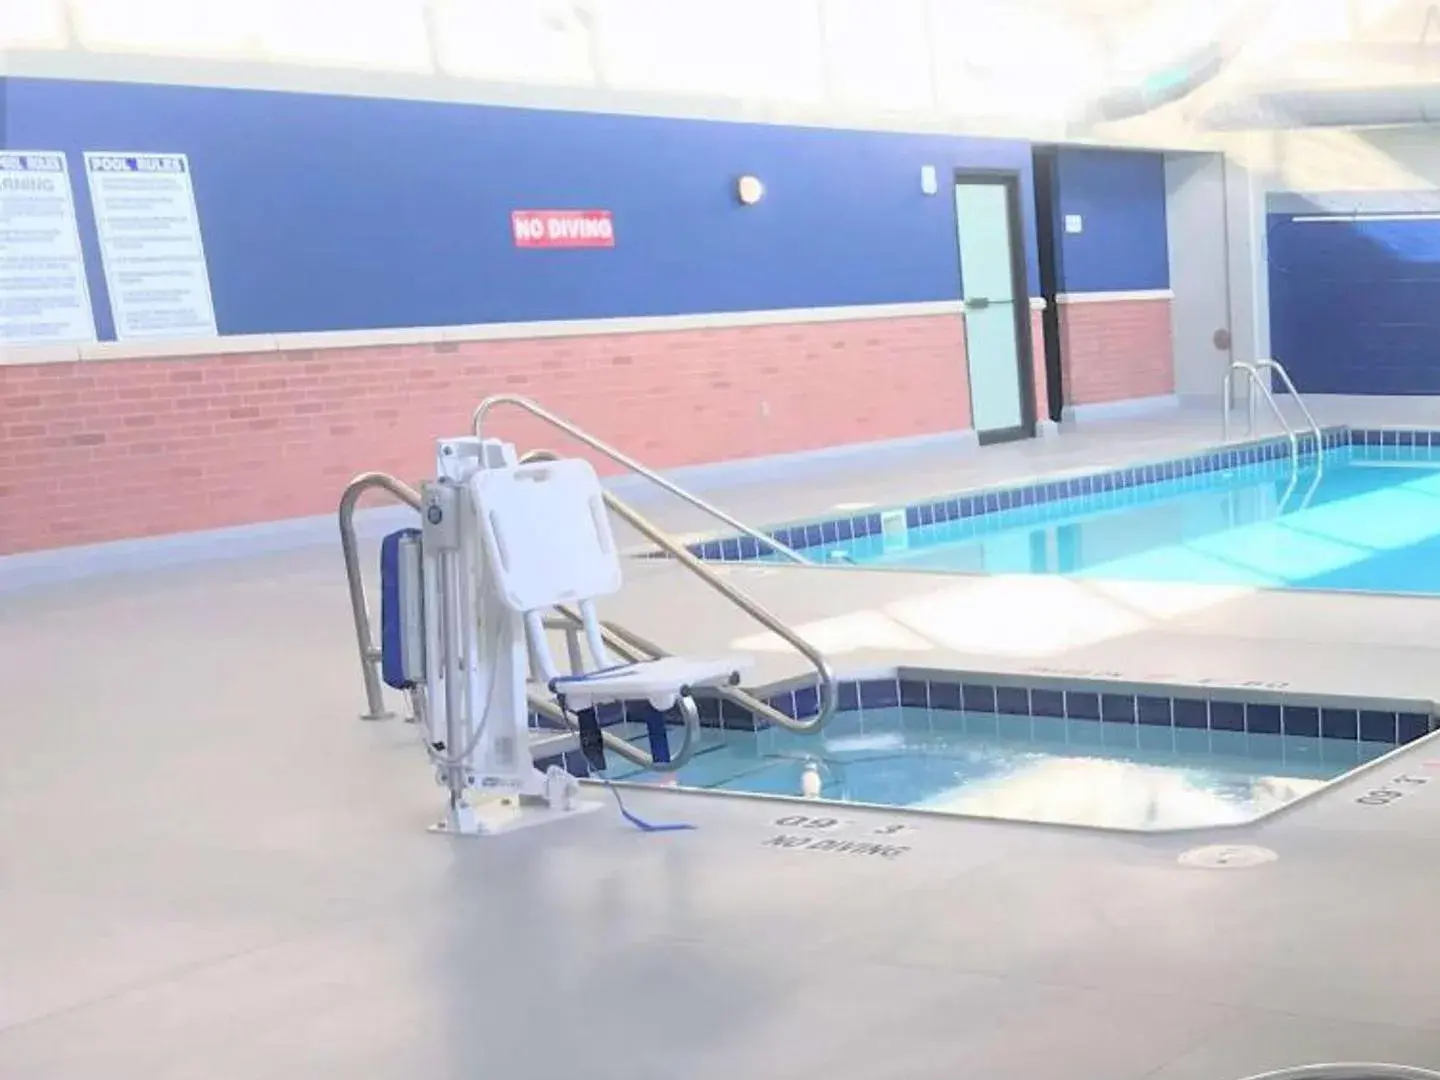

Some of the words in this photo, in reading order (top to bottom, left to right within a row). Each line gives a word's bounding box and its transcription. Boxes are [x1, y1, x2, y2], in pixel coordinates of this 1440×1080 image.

[0, 178, 54, 192] ARNING
[514, 218, 544, 238] NO
[548, 218, 612, 238] DIVING
